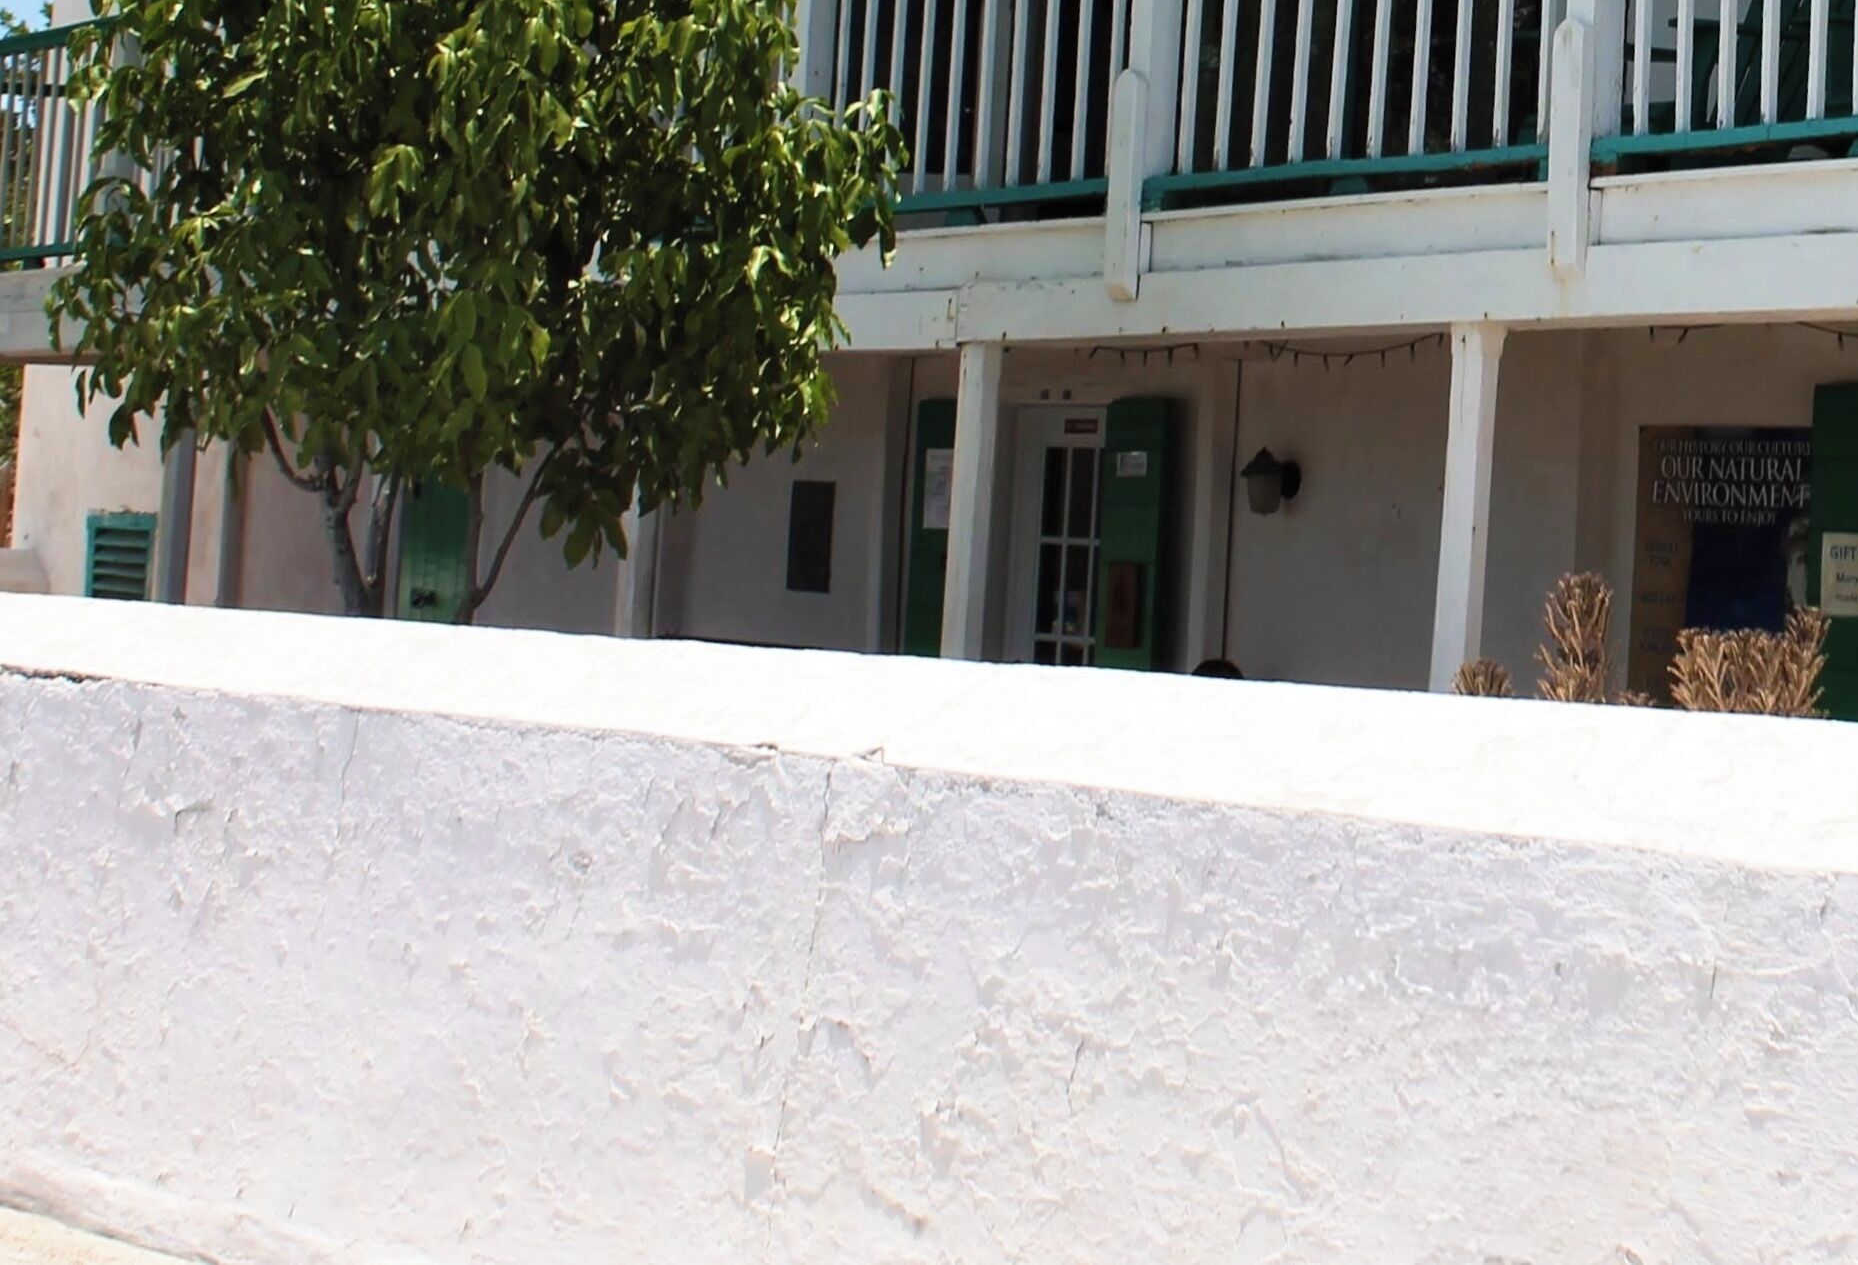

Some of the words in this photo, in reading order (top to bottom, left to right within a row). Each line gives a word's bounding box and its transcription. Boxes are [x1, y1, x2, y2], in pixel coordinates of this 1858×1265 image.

[1661, 455, 1703, 479] OUR
[1708, 457, 1804, 482] NATURAL
[1652, 480, 1812, 508] ENVIRONMENT
[1829, 545, 1857, 561] GIFT
